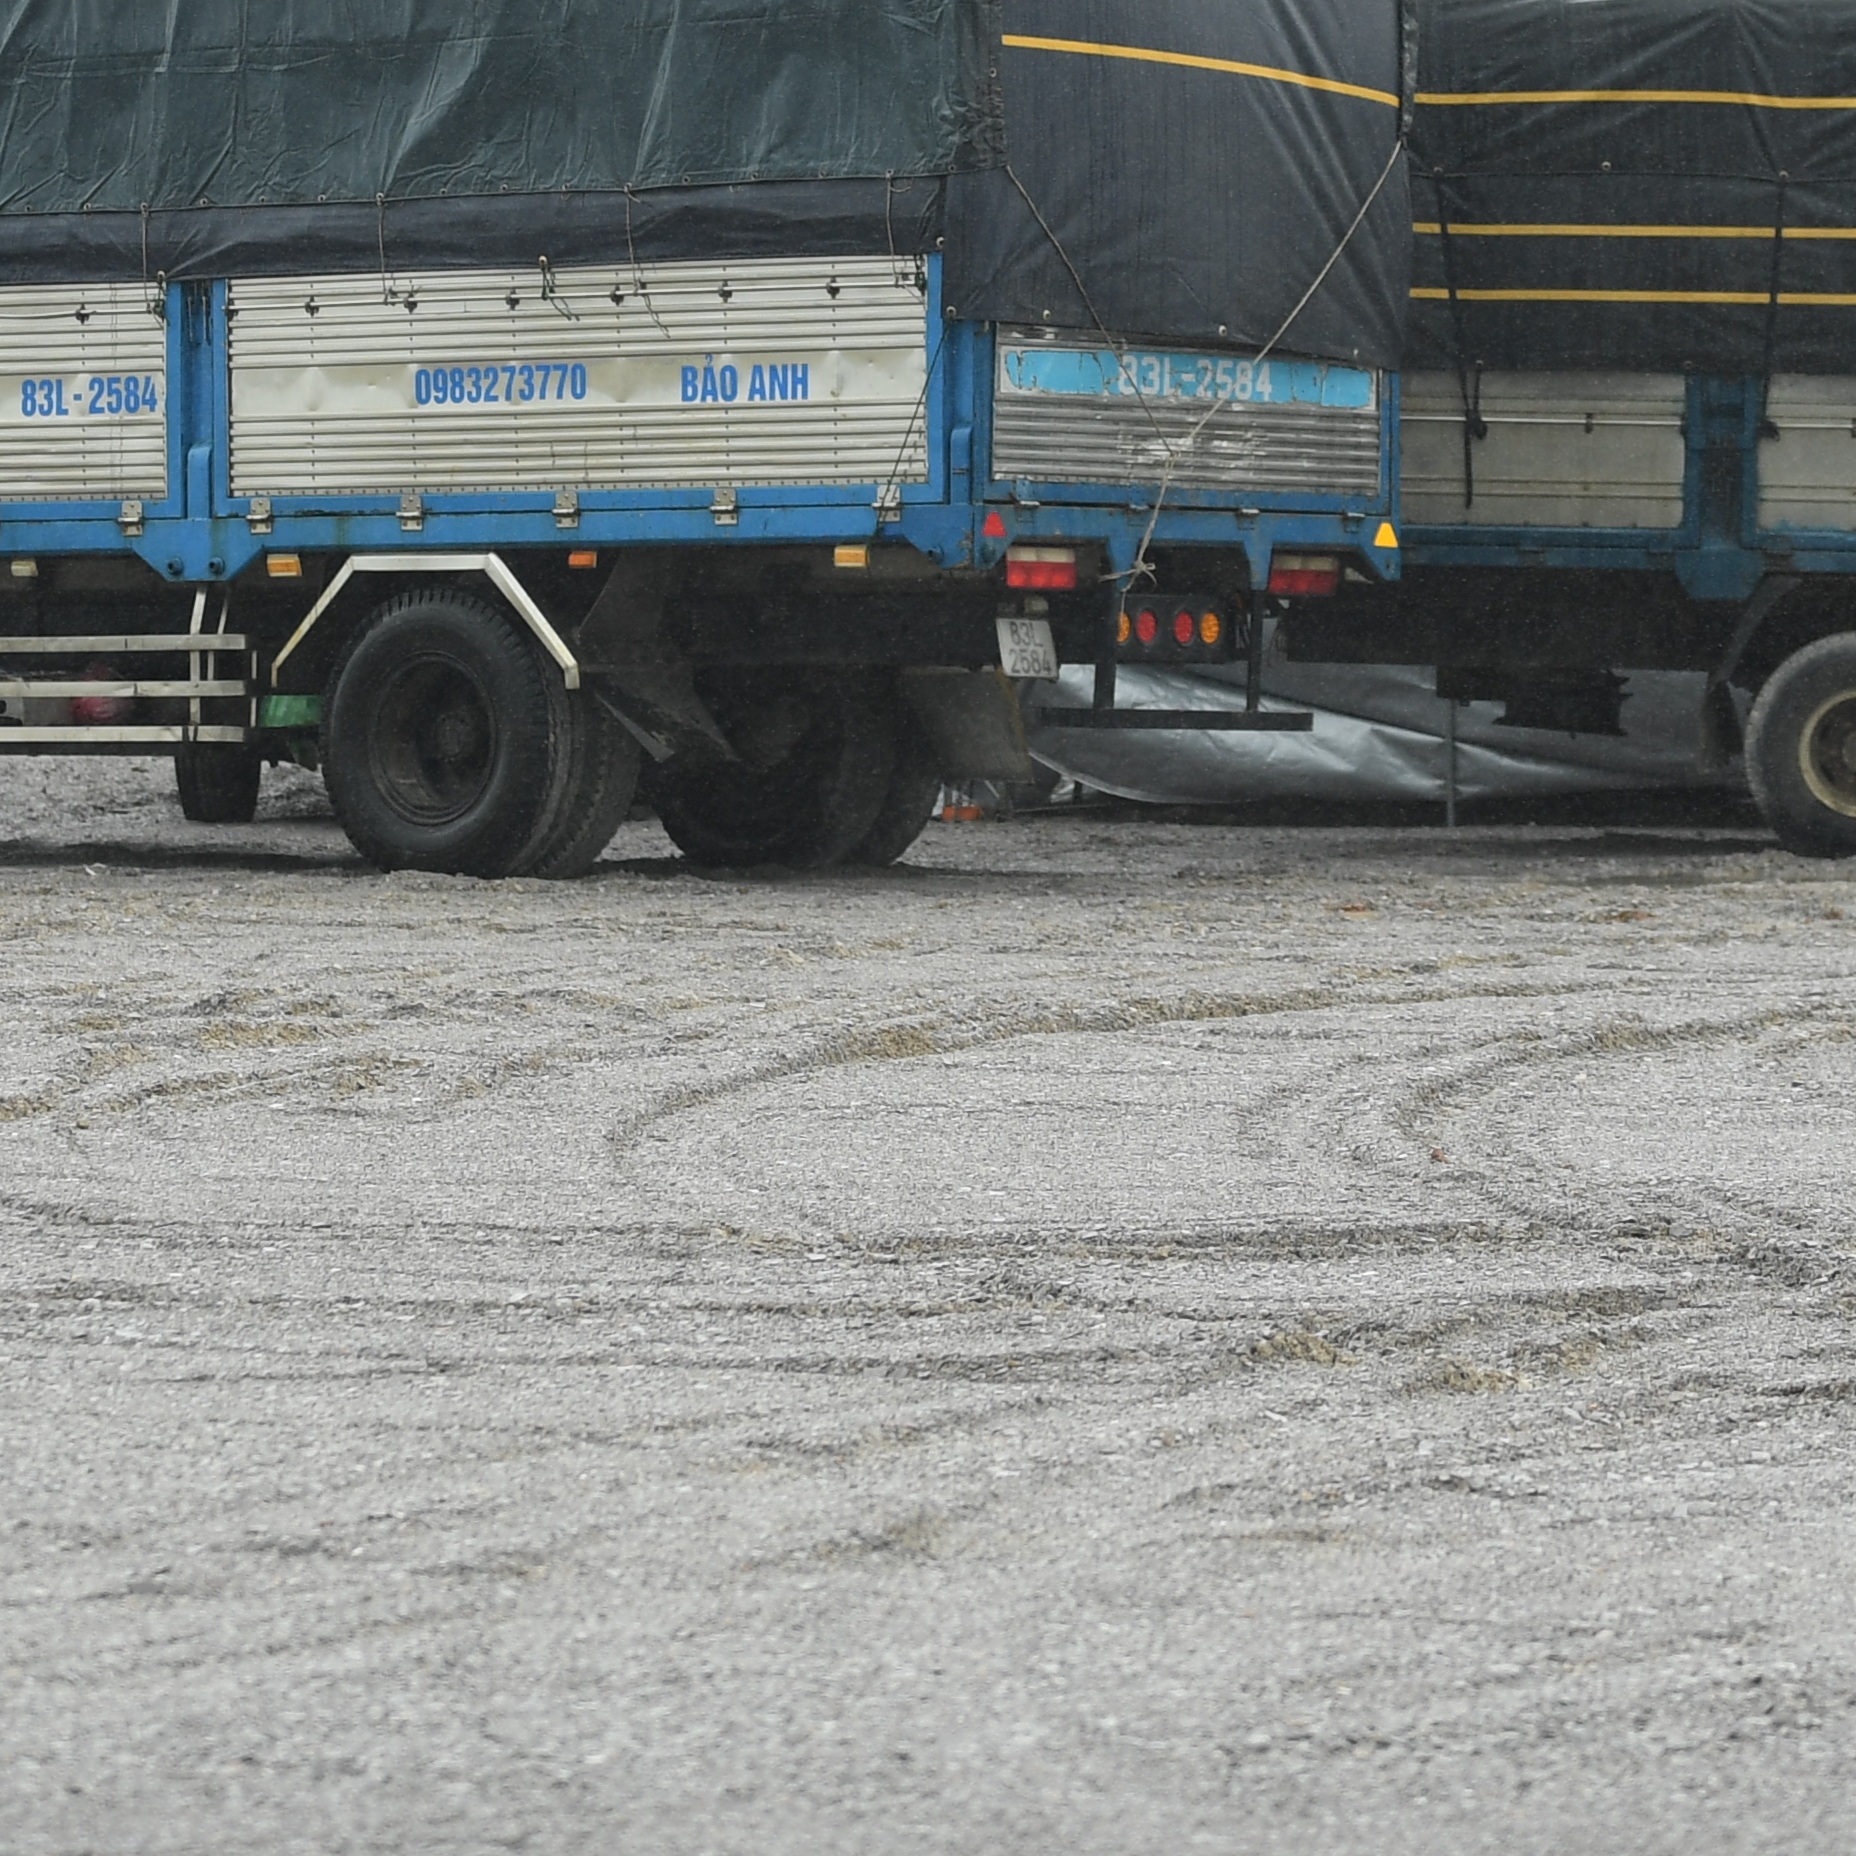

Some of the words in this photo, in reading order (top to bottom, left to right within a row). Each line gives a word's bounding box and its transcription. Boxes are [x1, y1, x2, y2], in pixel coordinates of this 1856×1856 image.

[415, 362, 587, 406] 0983273770
[680, 353, 739, 402] BẢO
[747, 362, 809, 402] ANH
[1009, 621, 1044, 648] 83L
[1008, 647, 1052, 676] 2584
